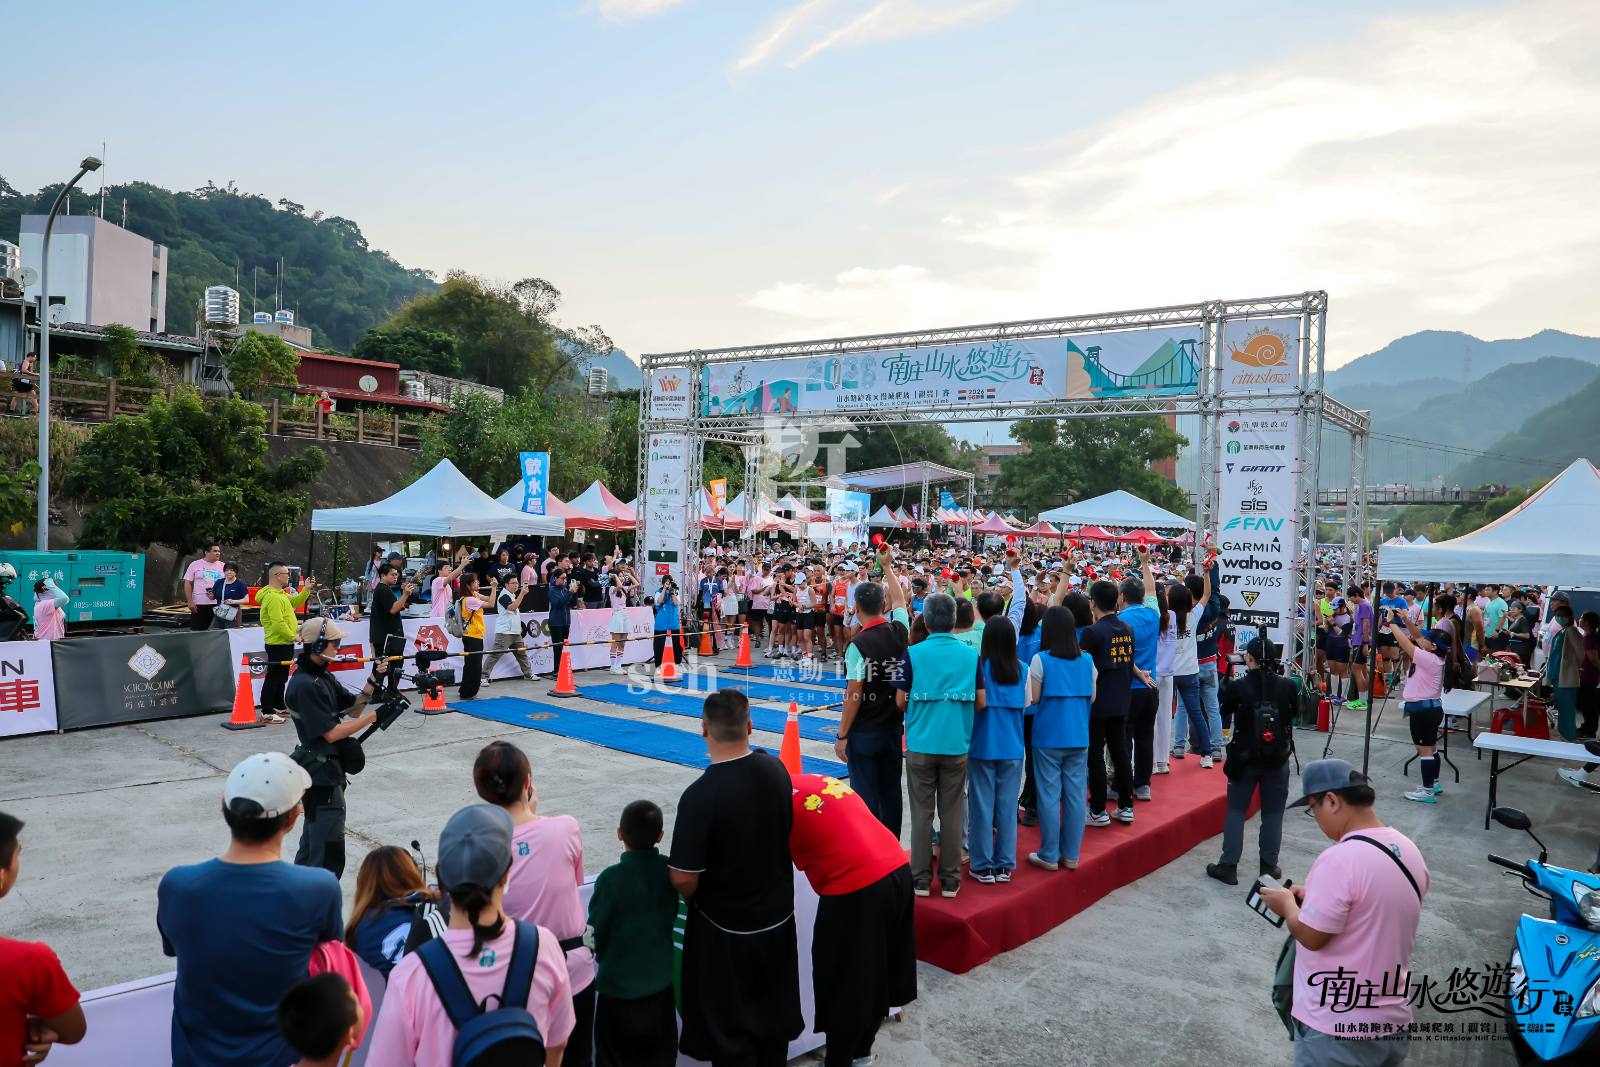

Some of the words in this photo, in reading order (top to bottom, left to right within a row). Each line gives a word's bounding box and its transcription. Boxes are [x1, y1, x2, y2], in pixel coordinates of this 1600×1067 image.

[881, 342, 1036, 386] 南庄山水悠遊行
[525, 457, 543, 513] 飲水區
[1222, 542, 1281, 552] GARMIN
[1222, 555, 1283, 571] wahoo
[1221, 574, 1241, 584] DT
[1245, 575, 1282, 587] SWISS
